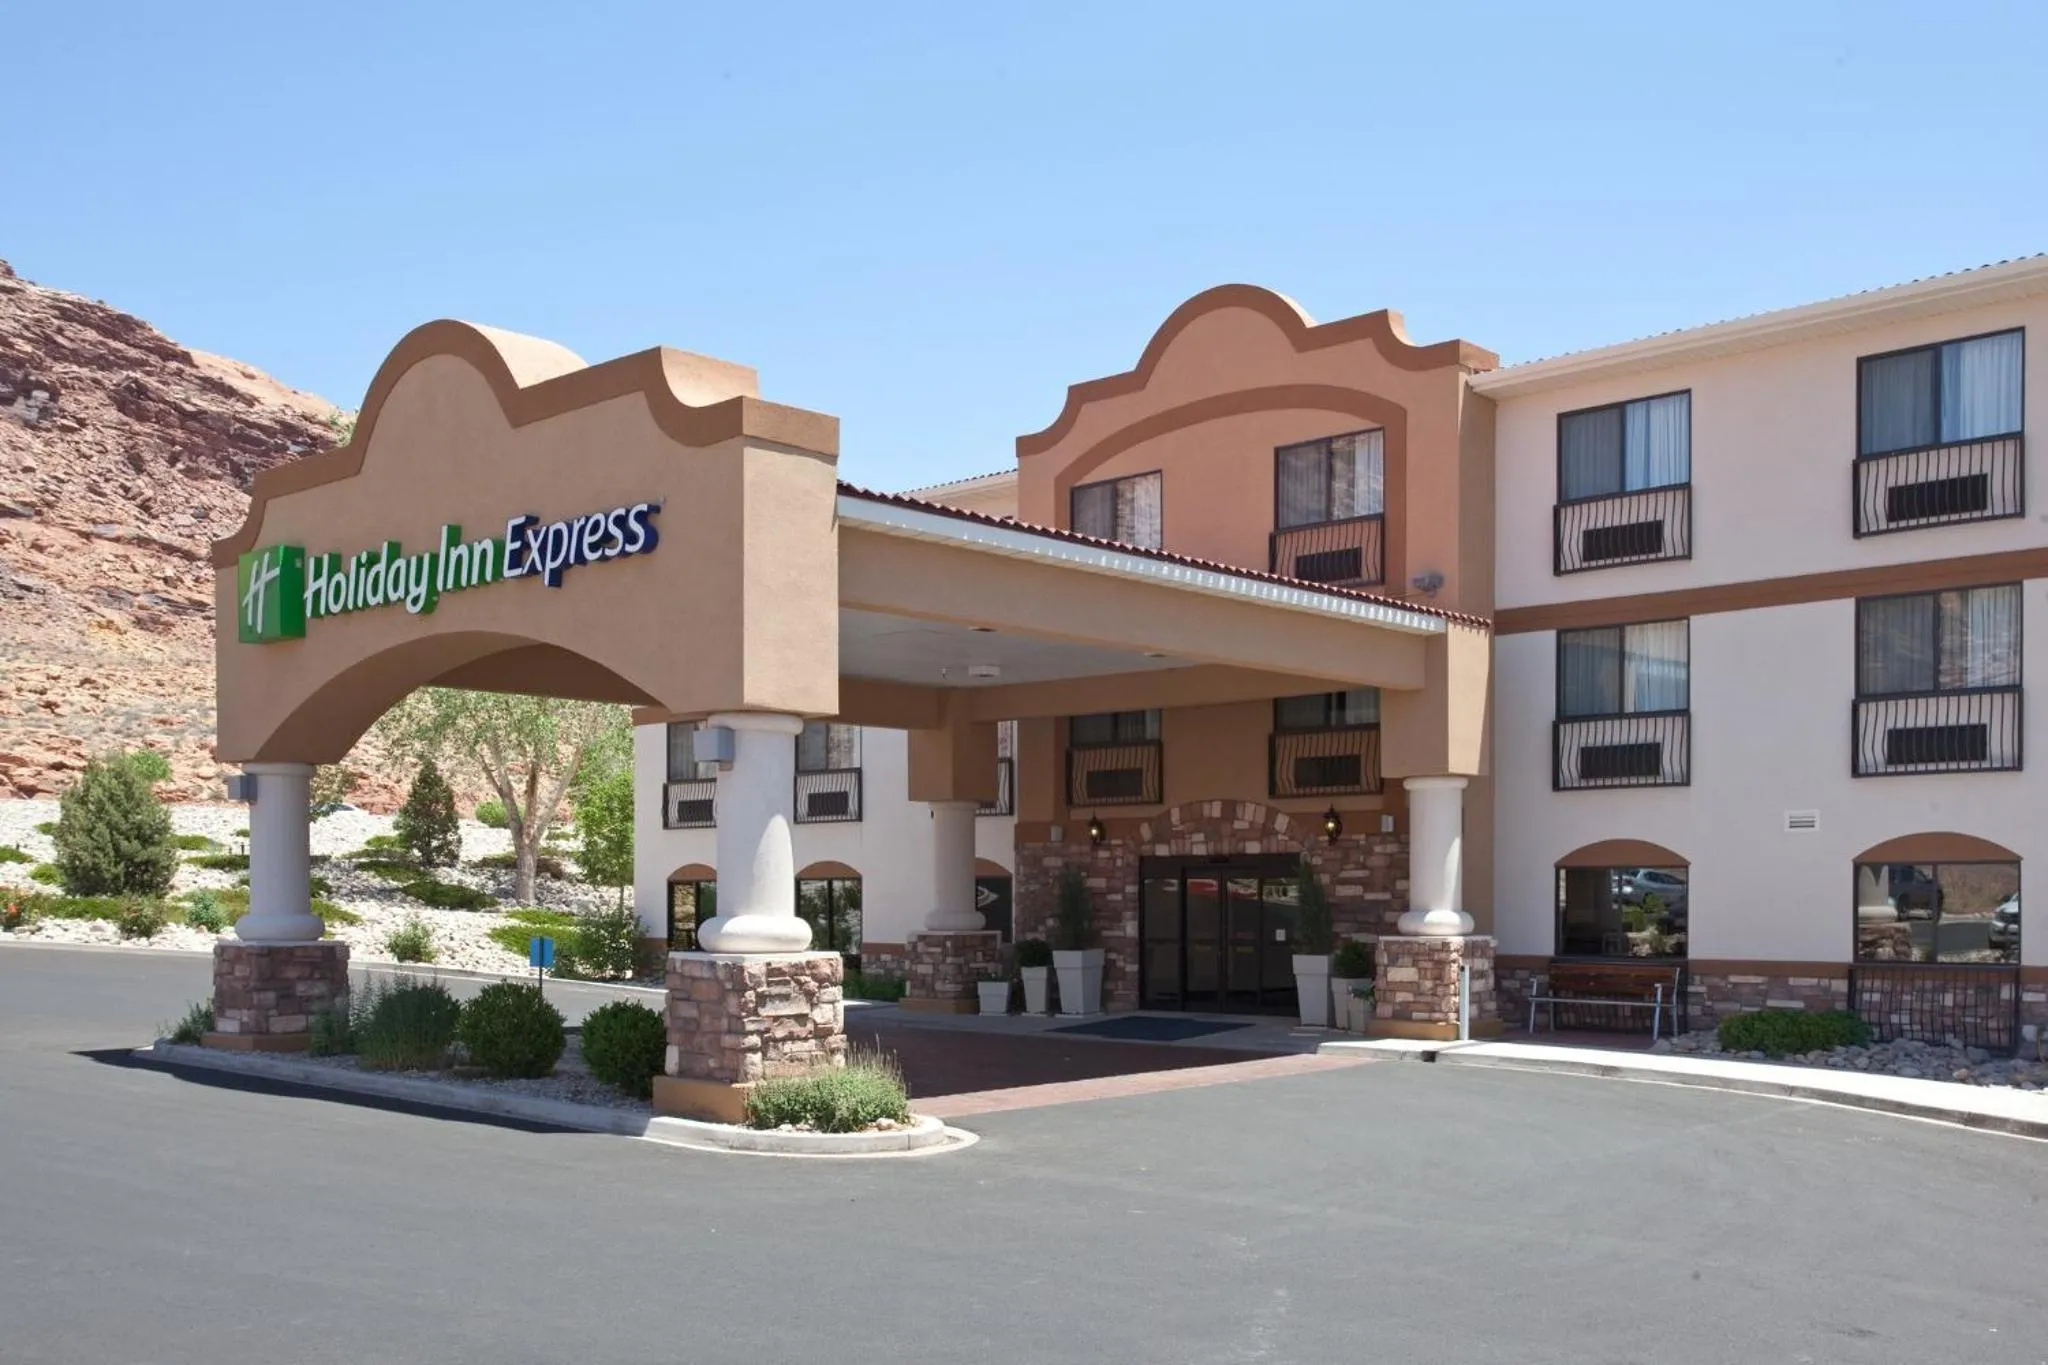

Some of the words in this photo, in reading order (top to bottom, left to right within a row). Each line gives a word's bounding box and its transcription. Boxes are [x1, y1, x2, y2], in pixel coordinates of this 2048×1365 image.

[303, 541, 431, 617] Holiday
[436, 524, 496, 593] Inn
[503, 502, 652, 587] Express
